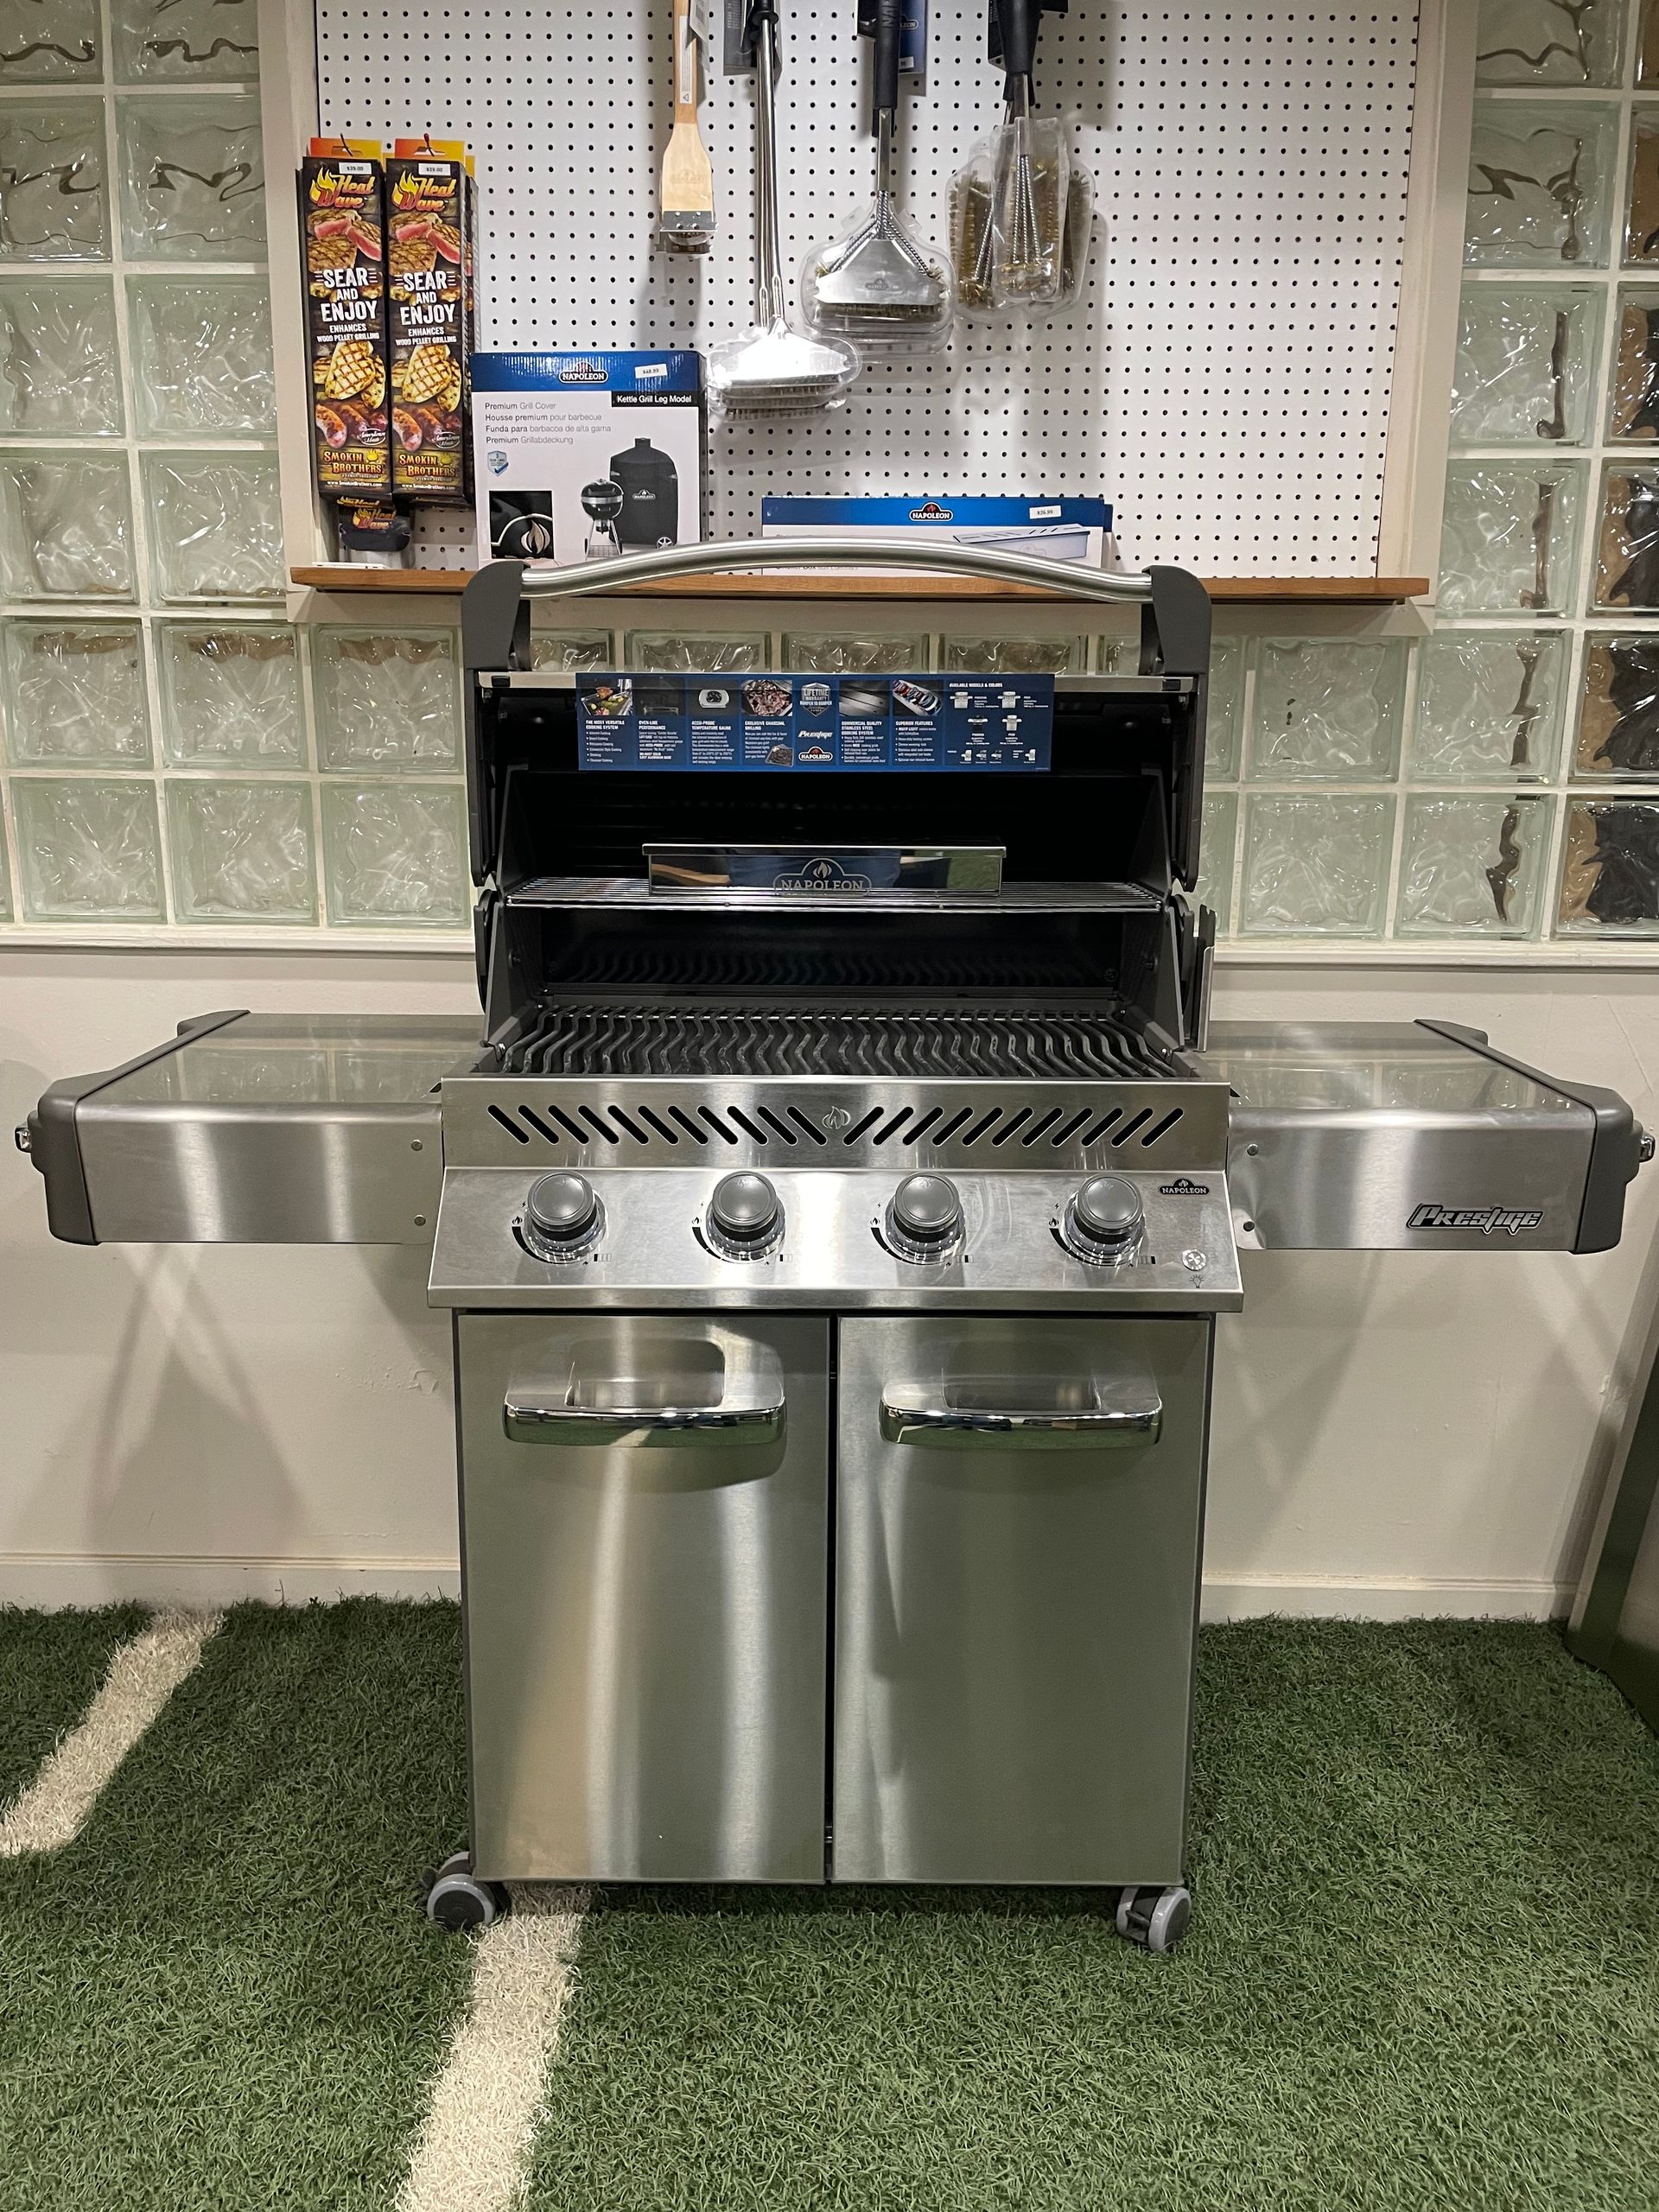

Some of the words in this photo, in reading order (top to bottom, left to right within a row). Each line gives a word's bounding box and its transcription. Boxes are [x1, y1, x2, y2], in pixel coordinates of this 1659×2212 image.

[330, 172, 375, 194] Heat
[412, 175, 456, 198] Heat
[316, 189, 364, 208] Wave
[398, 192, 445, 212] Wave
[323, 268, 369, 289] SEAR
[403, 270, 448, 292] SEAR
[336, 289, 359, 301] AND
[416, 292, 437, 304] AND
[321, 301, 377, 322] ENJOY
[400, 304, 455, 326] ENJOY
[329, 323, 367, 334] ENHANCES
[408, 327, 444, 337] ENHANCES
[654, 396, 668, 404] Leg
[520, 436, 574, 445] Grillabdeckung
[332, 462, 383, 474] BROTHERS
[407, 465, 456, 477] BROTHERS
[798, 730, 833, 740] Prestige
